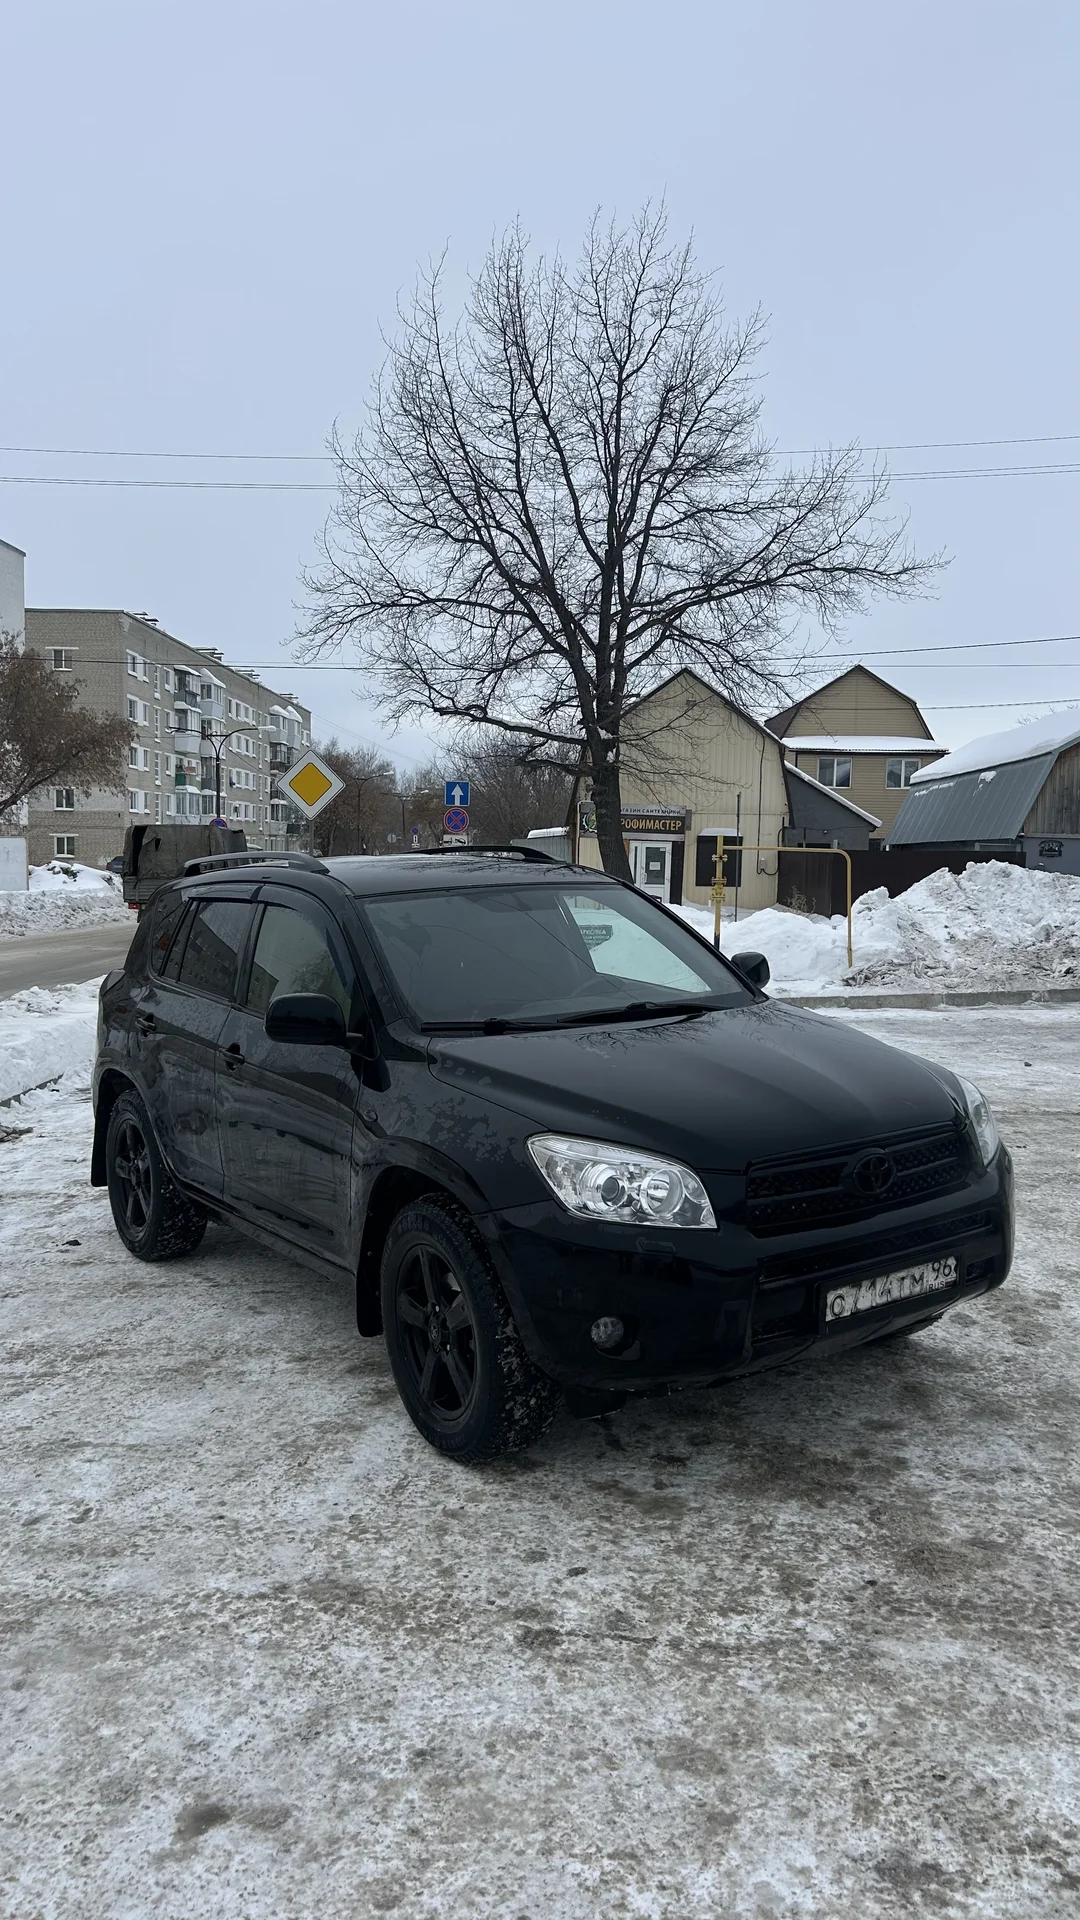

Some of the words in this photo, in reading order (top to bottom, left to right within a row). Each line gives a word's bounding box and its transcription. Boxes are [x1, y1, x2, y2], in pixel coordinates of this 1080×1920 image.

[620, 818, 682, 831] РОФИМАСТЕР
[931, 1257, 953, 1281] 96
[927, 1280, 946, 1293] RUS
